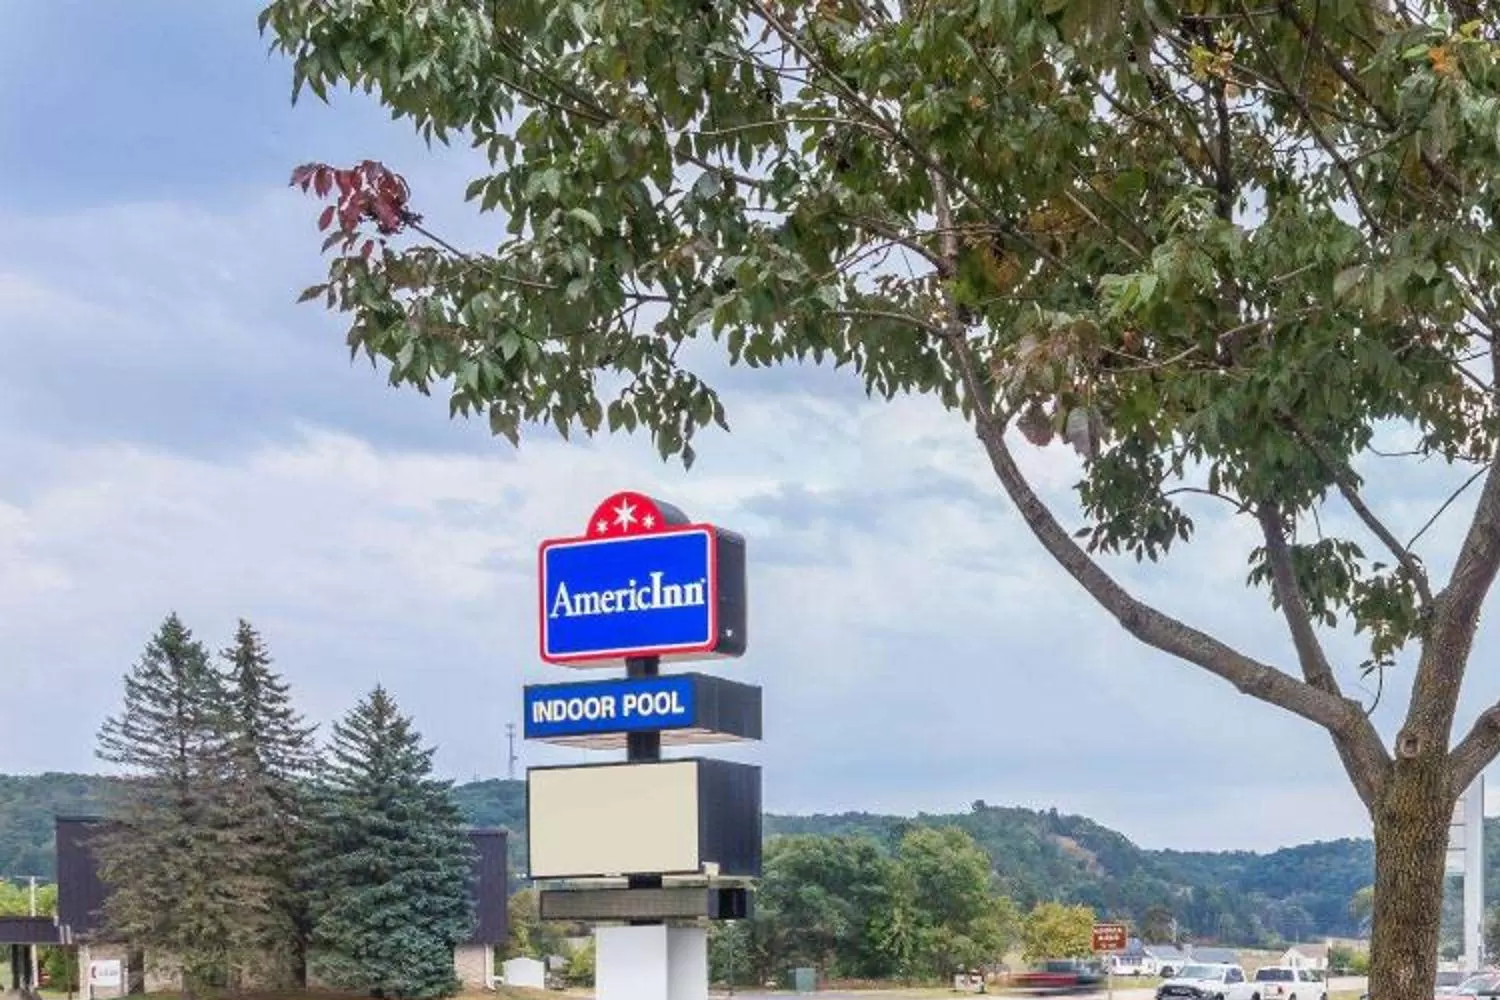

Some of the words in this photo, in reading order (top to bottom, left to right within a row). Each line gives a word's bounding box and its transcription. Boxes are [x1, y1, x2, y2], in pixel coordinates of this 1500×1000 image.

[550, 572, 705, 618] AmericInn
[532, 695, 616, 723] INDOOR
[622, 691, 685, 717] POOL
